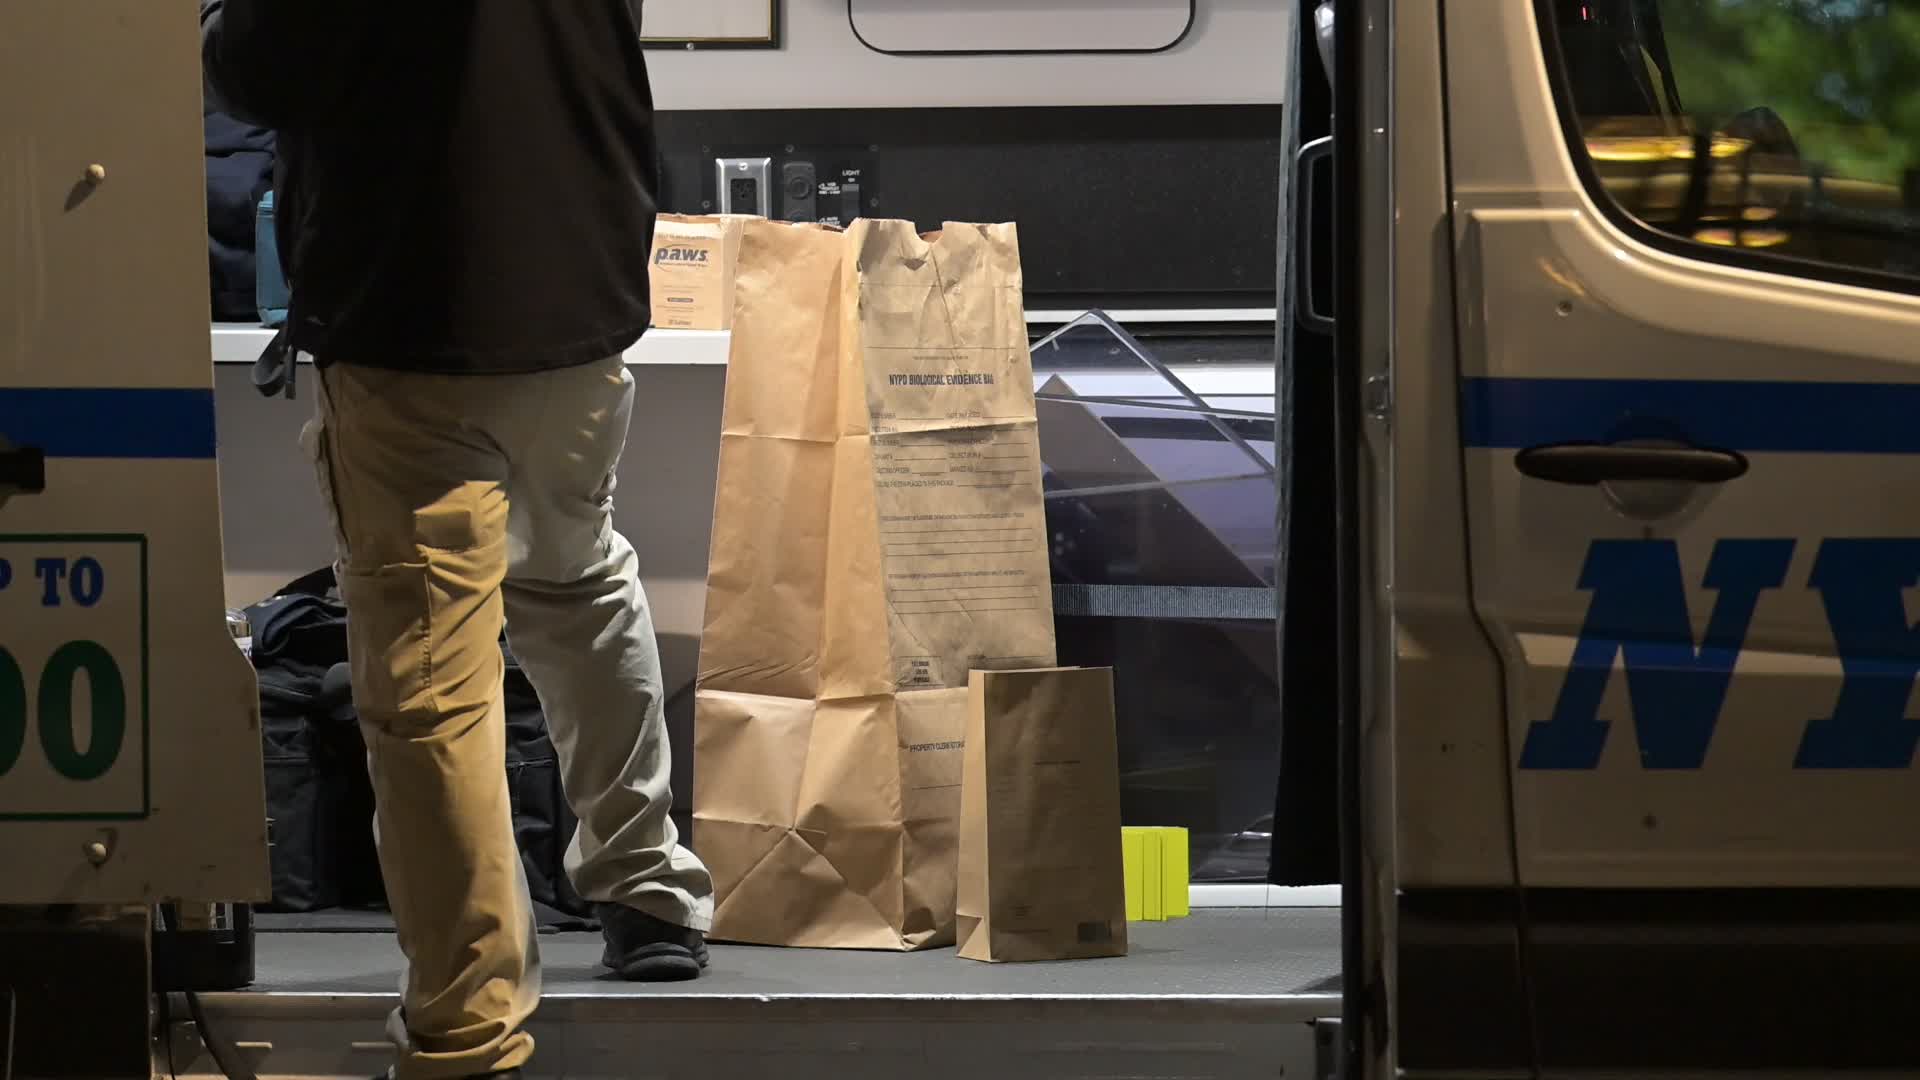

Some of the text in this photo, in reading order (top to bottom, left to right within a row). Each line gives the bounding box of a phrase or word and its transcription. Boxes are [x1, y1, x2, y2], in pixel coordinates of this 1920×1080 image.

[889, 374, 908, 385] NYPD
[909, 374, 945, 385] BIOLOGICAL
[946, 374, 983, 385] EVIDENCE
[35, 556, 105, 607] TO
[910, 743, 936, 752] PROPERTY
